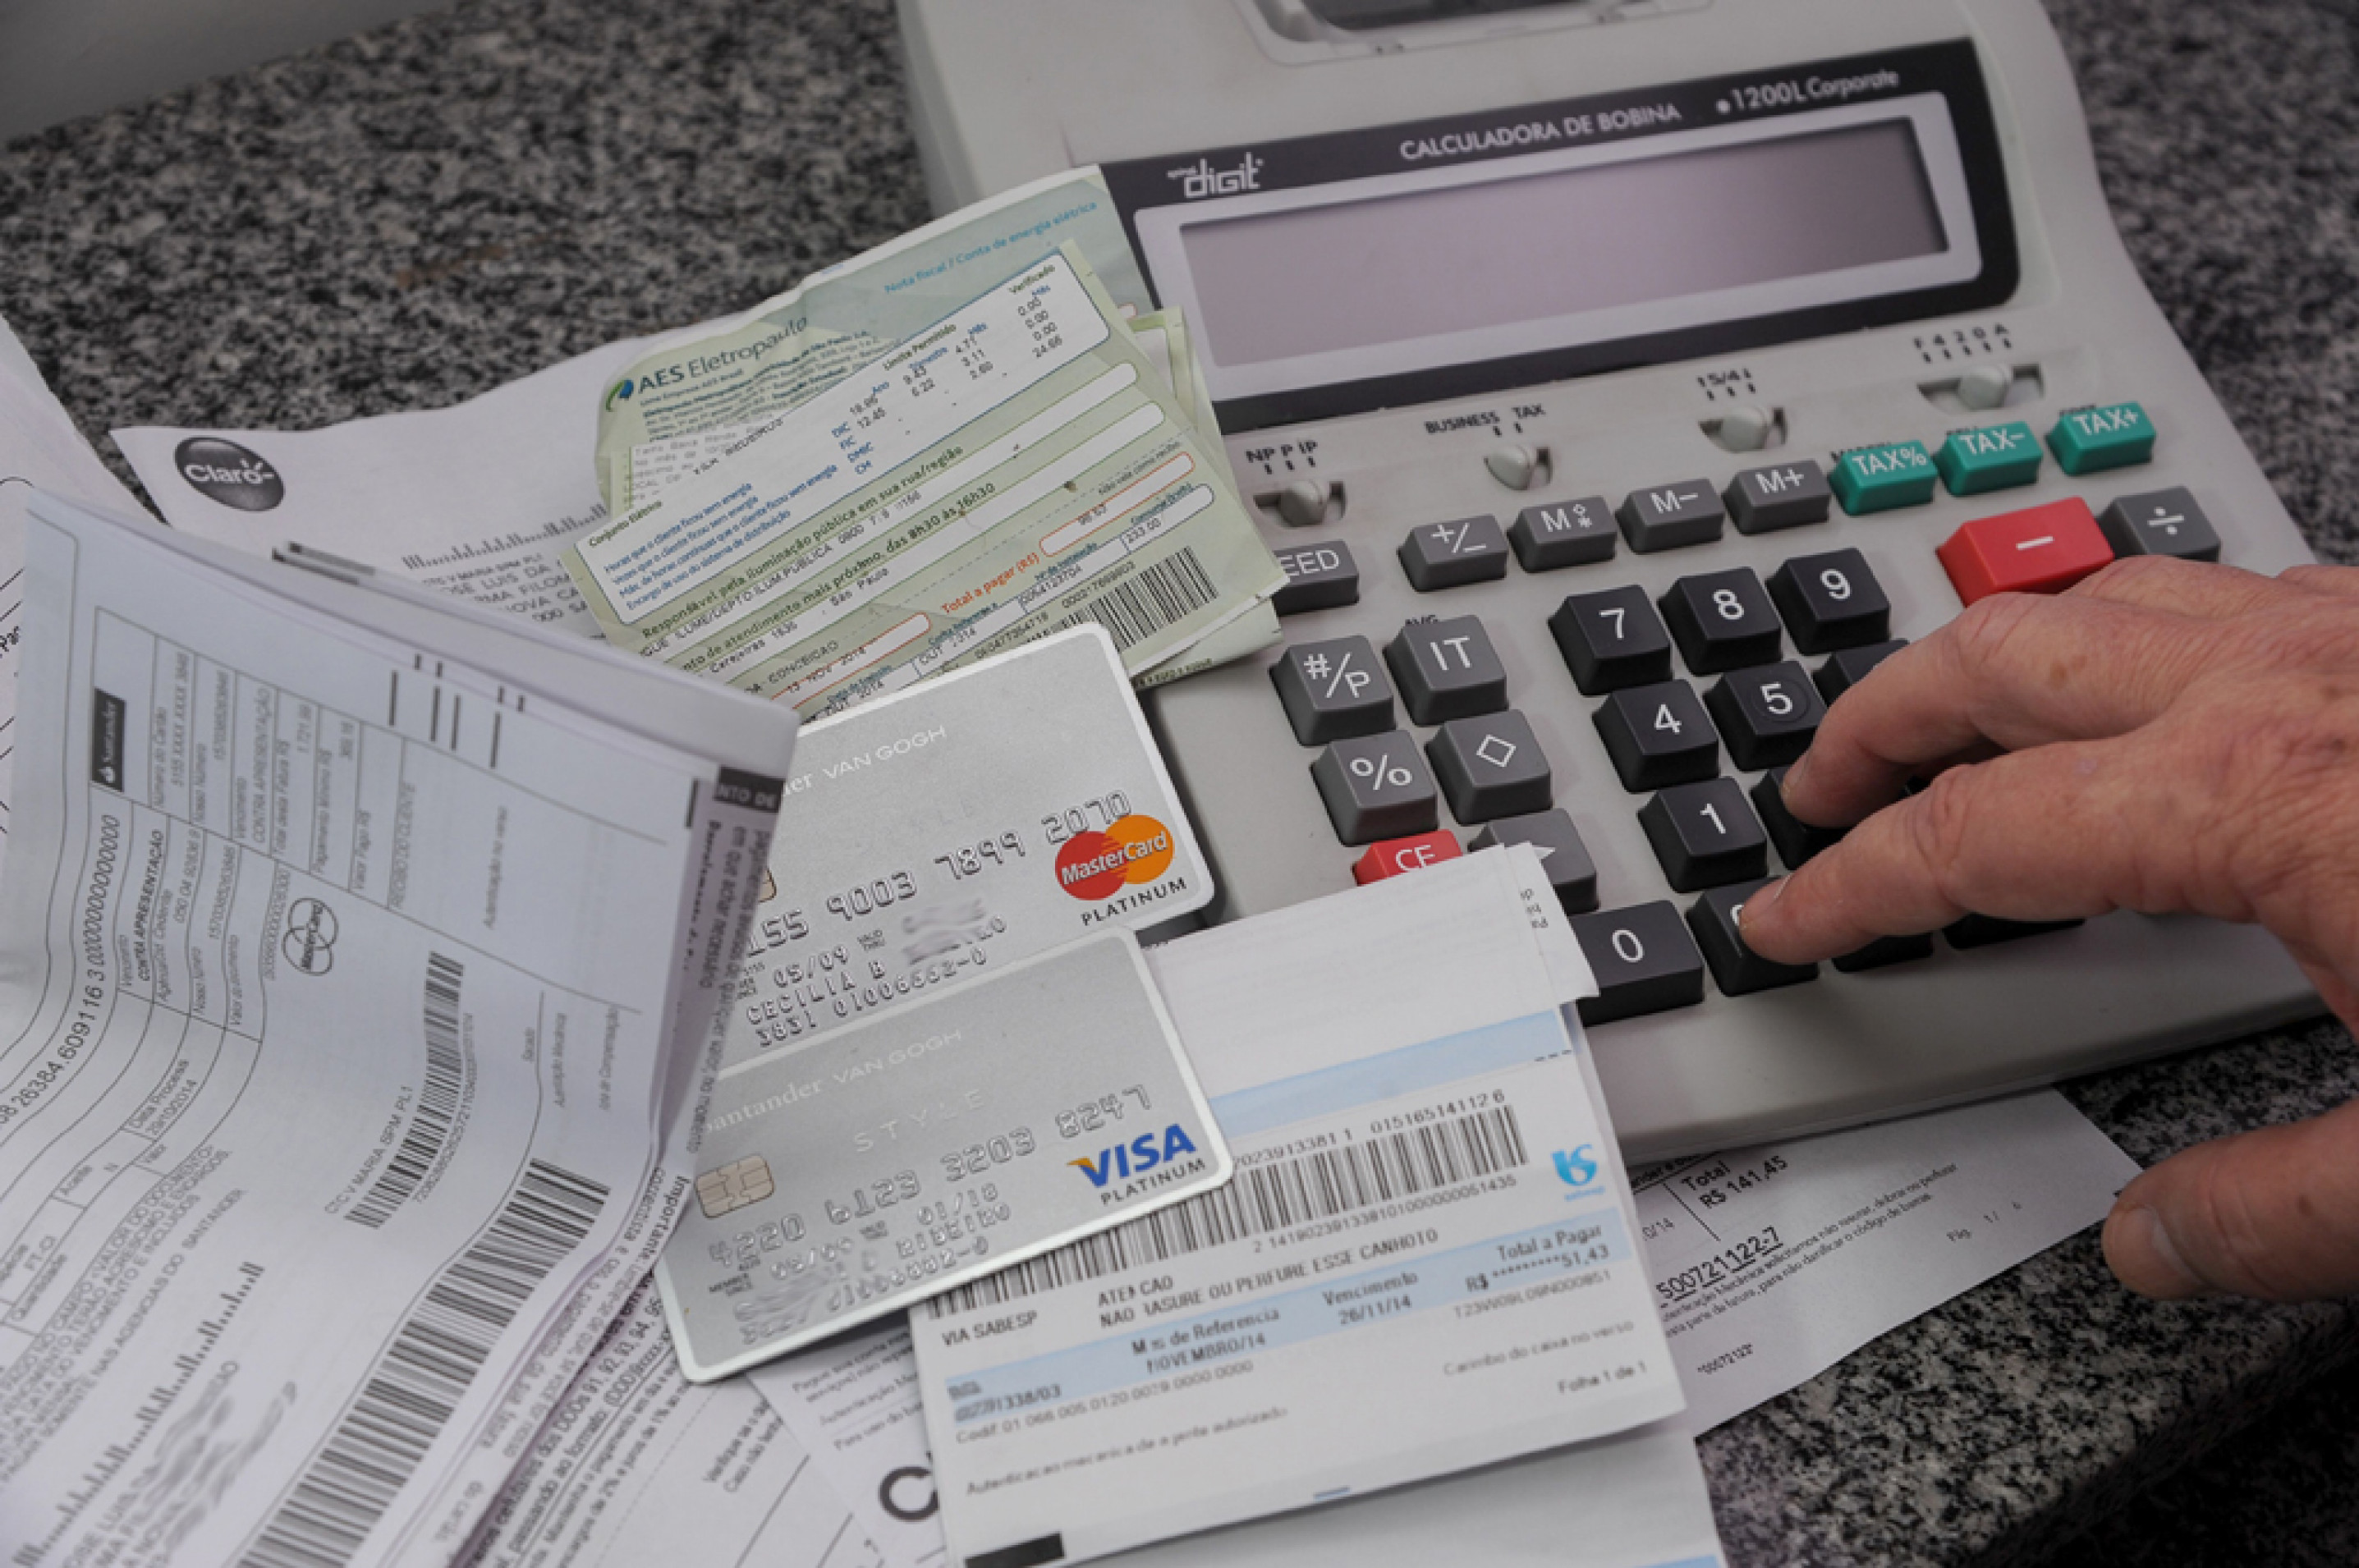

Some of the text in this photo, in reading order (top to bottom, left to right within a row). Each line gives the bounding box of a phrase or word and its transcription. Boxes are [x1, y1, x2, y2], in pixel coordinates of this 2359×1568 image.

[1400, 70, 1898, 160] CALCULADORA DE BOBINA 1200L Corporate
[1008, 265, 1055, 294] Verificado
[639, 365, 684, 393] AES
[688, 313, 809, 378] Eletropaulo
[1425, 405, 1544, 433] BUSINESS TAX
[2072, 409, 2137, 434] TAX+
[1246, 449, 1274, 462] NP
[1281, 442, 1295, 456] P
[1852, 443, 1928, 475] TAX%
[181, 459, 263, 484] Claro
[1756, 469, 1803, 493] M+
[641, 447, 962, 639] Responsável pela iluminação pública em sua rua/região
[1278, 550, 1339, 580] EED
[942, 592, 973, 613] Total
[984, 567, 1014, 594] pagar
[1017, 552, 1039, 572] (R$)
[1820, 569, 1851, 599] 9
[1713, 589, 1744, 620] 8
[1599, 608, 1624, 639] 7
[1430, 636, 1471, 671] IT
[1761, 683, 1792, 714] 5
[1655, 704, 1681, 733] 4
[823, 725, 946, 778] VAN GOGH
[1700, 803, 1726, 834] 1
[1056, 830, 1173, 887] MasterCard
[1081, 878, 1186, 926] PLATINUM
[1612, 929, 1644, 962] 0
[833, 1058, 883, 1083] VAN
[888, 1029, 961, 1064] GOGH
[1069, 1124, 1201, 1187] VISA
[704, 1084, 1150, 1268] 4220 6123 3203 8247
[1096, 1158, 1211, 1204] PLATINUM
[1681, 1158, 1730, 1197] Total
[1700, 1155, 1787, 1211] R$ 141,45
[636, 1176, 700, 1259] Importante:
[1498, 1226, 1601, 1260] Total a Pagar
[1323, 1272, 1418, 1306] Vencimento
[1339, 1295, 1411, 1325] 26/11/14
[943, 1310, 1037, 1346] VIA SABESP
[1170, 1309, 1279, 1346] de Referencia
[1558, 1361, 1645, 1392] Folha 1 de 1
